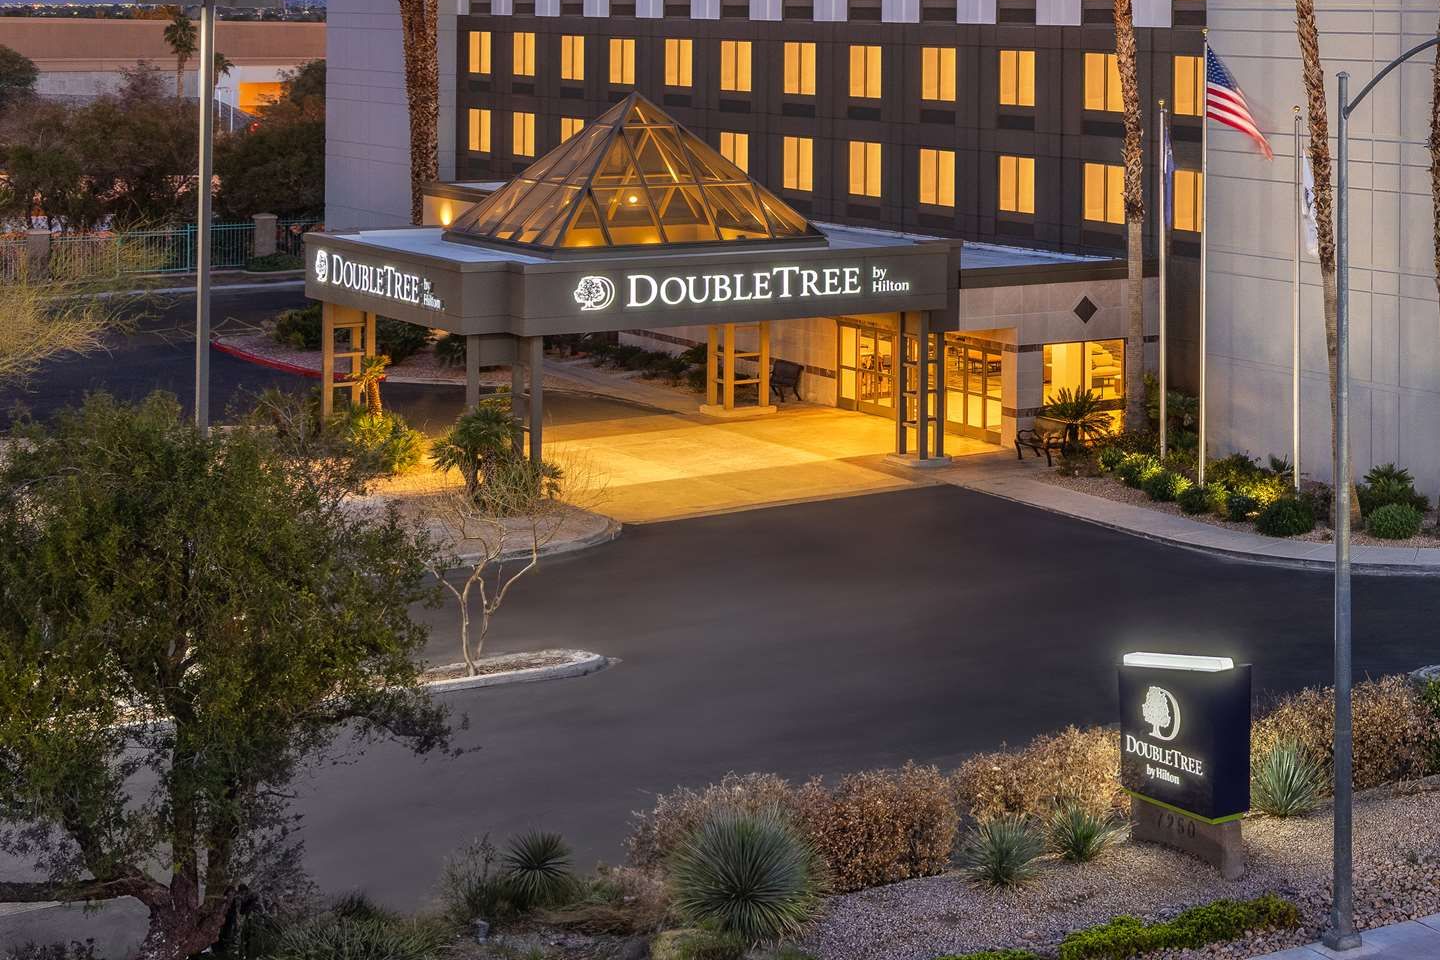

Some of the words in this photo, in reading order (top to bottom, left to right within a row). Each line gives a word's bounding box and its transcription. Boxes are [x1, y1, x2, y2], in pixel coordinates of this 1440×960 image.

[331, 254, 420, 304] DOUBLETREE
[626, 266, 862, 308] DOUBLETREE
[872, 266, 887, 281] by
[872, 279, 910, 293] Hilton
[1125, 734, 1204, 777] DOUBLETREE
[1146, 764, 1156, 779] by
[1156, 768, 1180, 785] Hilton
